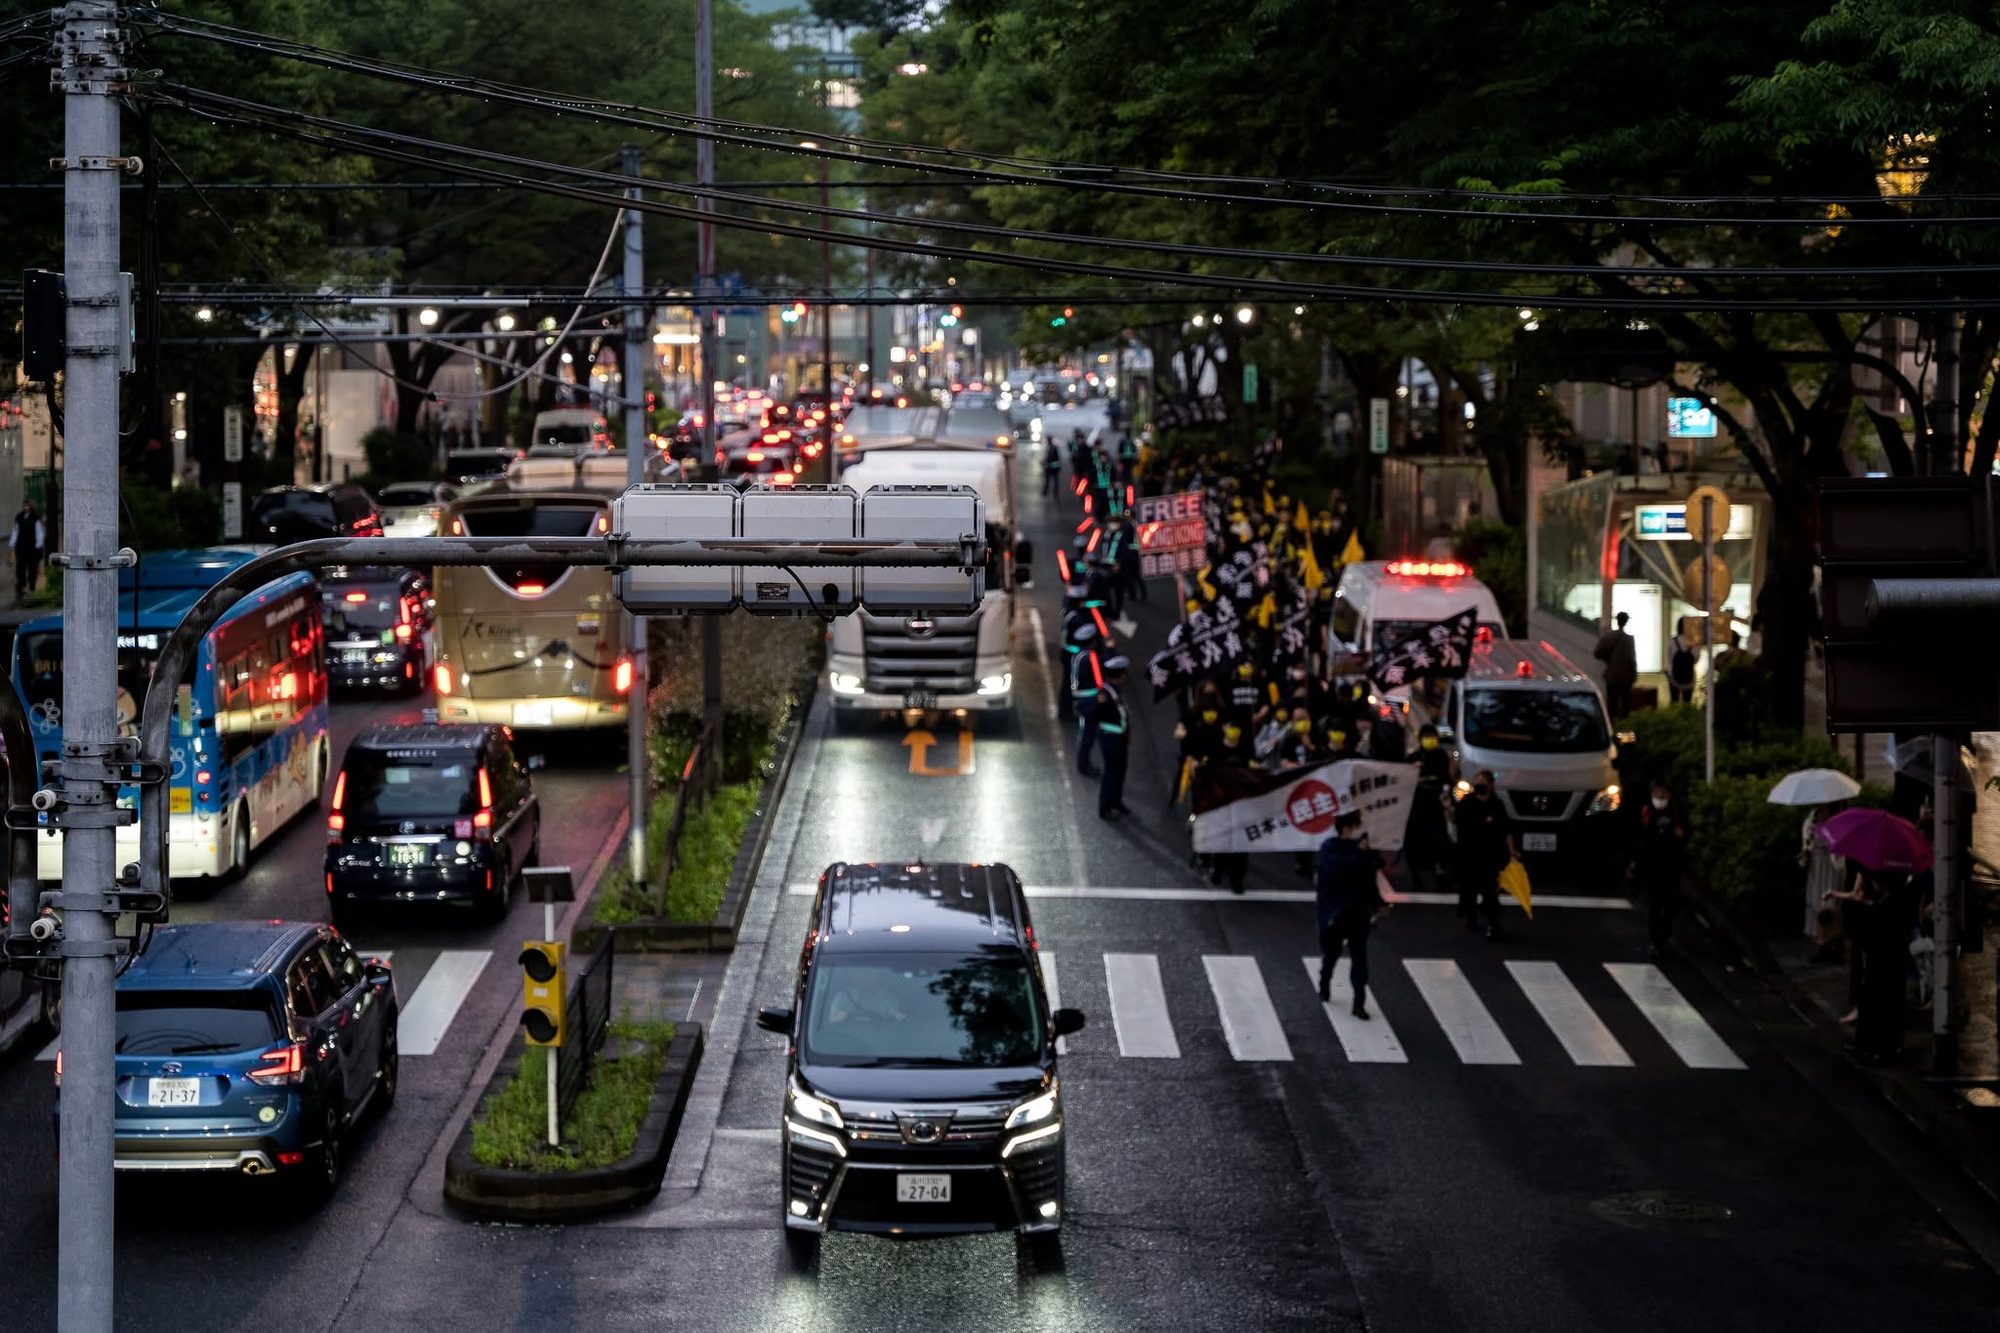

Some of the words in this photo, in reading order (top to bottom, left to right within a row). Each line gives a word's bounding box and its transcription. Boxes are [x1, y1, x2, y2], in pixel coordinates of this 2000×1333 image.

[1141, 495, 1201, 522] FREE
[160, 1090, 196, 1103] 21-37
[909, 1185, 948, 1200] 27-04
